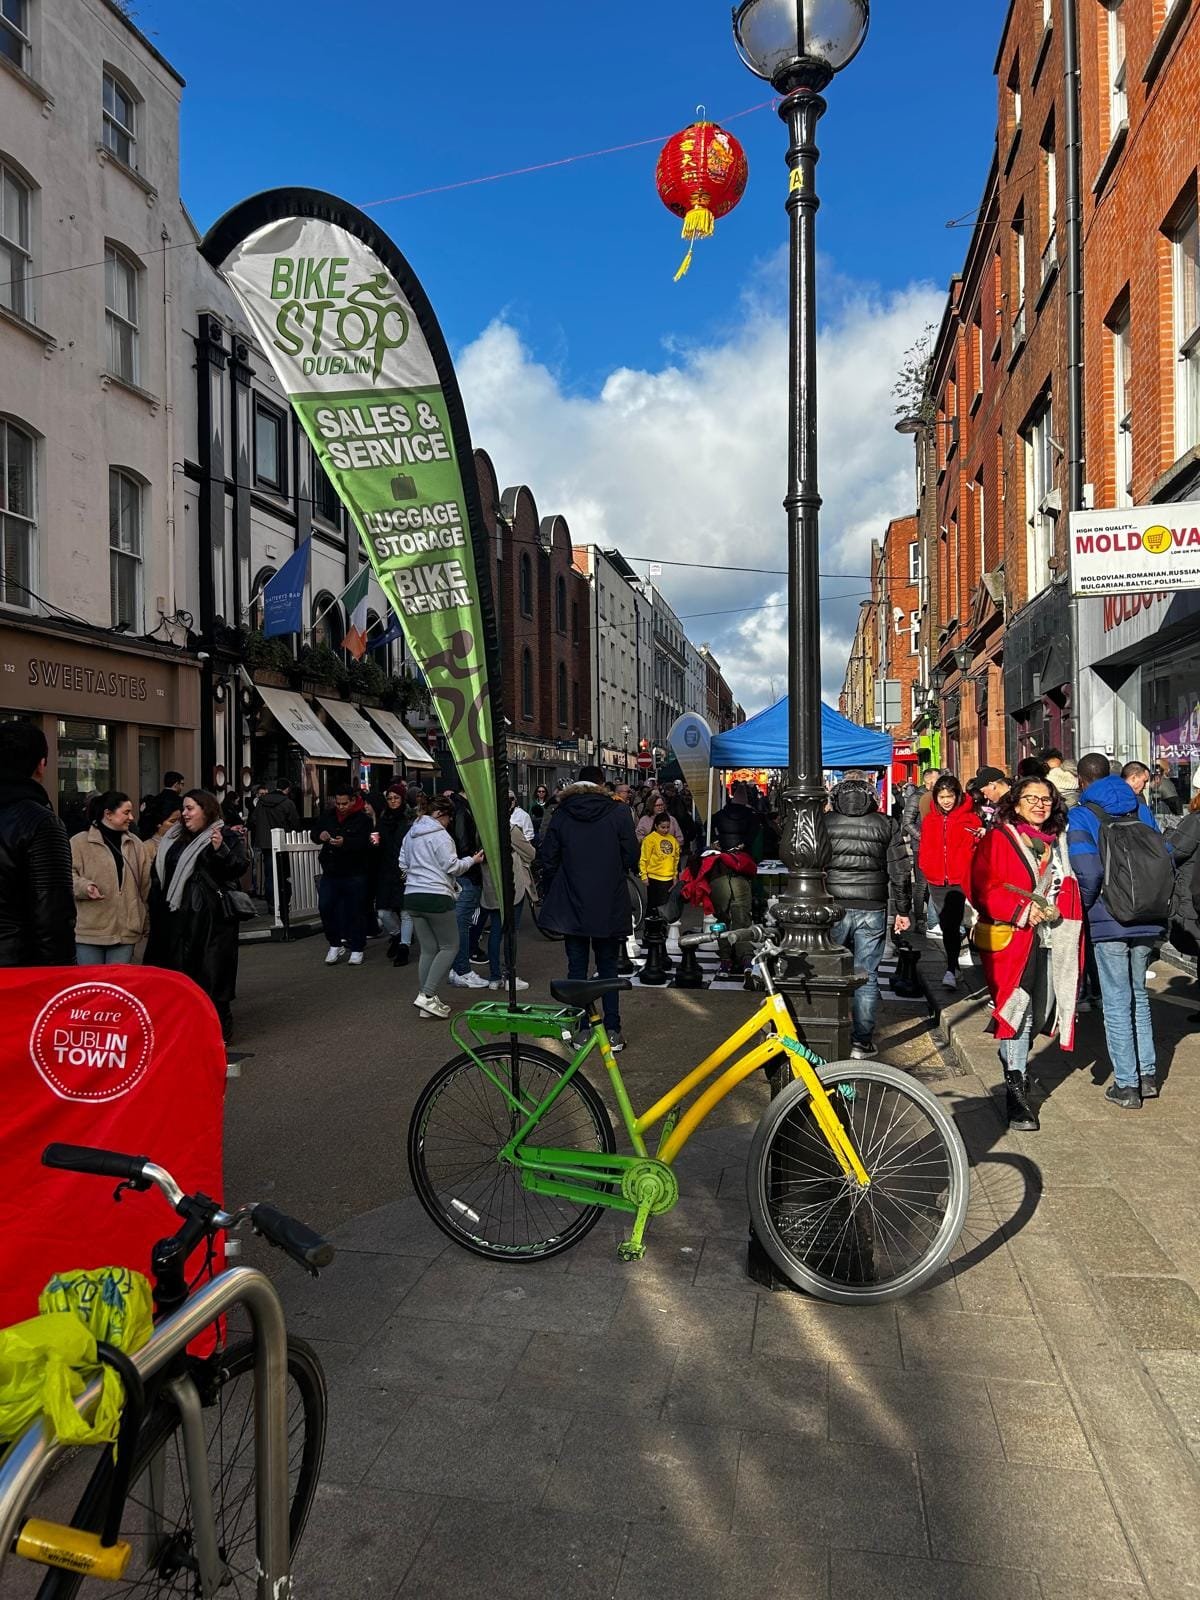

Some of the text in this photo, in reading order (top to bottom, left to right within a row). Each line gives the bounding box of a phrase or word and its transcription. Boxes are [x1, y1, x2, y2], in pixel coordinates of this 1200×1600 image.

[270, 257, 350, 300] BIKE
[303, 356, 374, 376] DUBLIN
[316, 402, 439, 438] SALES &
[326, 433, 451, 469] SERVICE
[362, 502, 462, 534] LUGGAGE
[374, 526, 466, 558] STORAGE
[393, 560, 468, 597] BIKE
[401, 588, 474, 615] RENTAL
[4, 663, 16, 673] 132
[28, 658, 148, 701] SWEETASTES
[69, 1008, 122, 1023] we are
[53, 1029, 128, 1052] DUBLIN
[53, 1046, 127, 1069] TOWN
